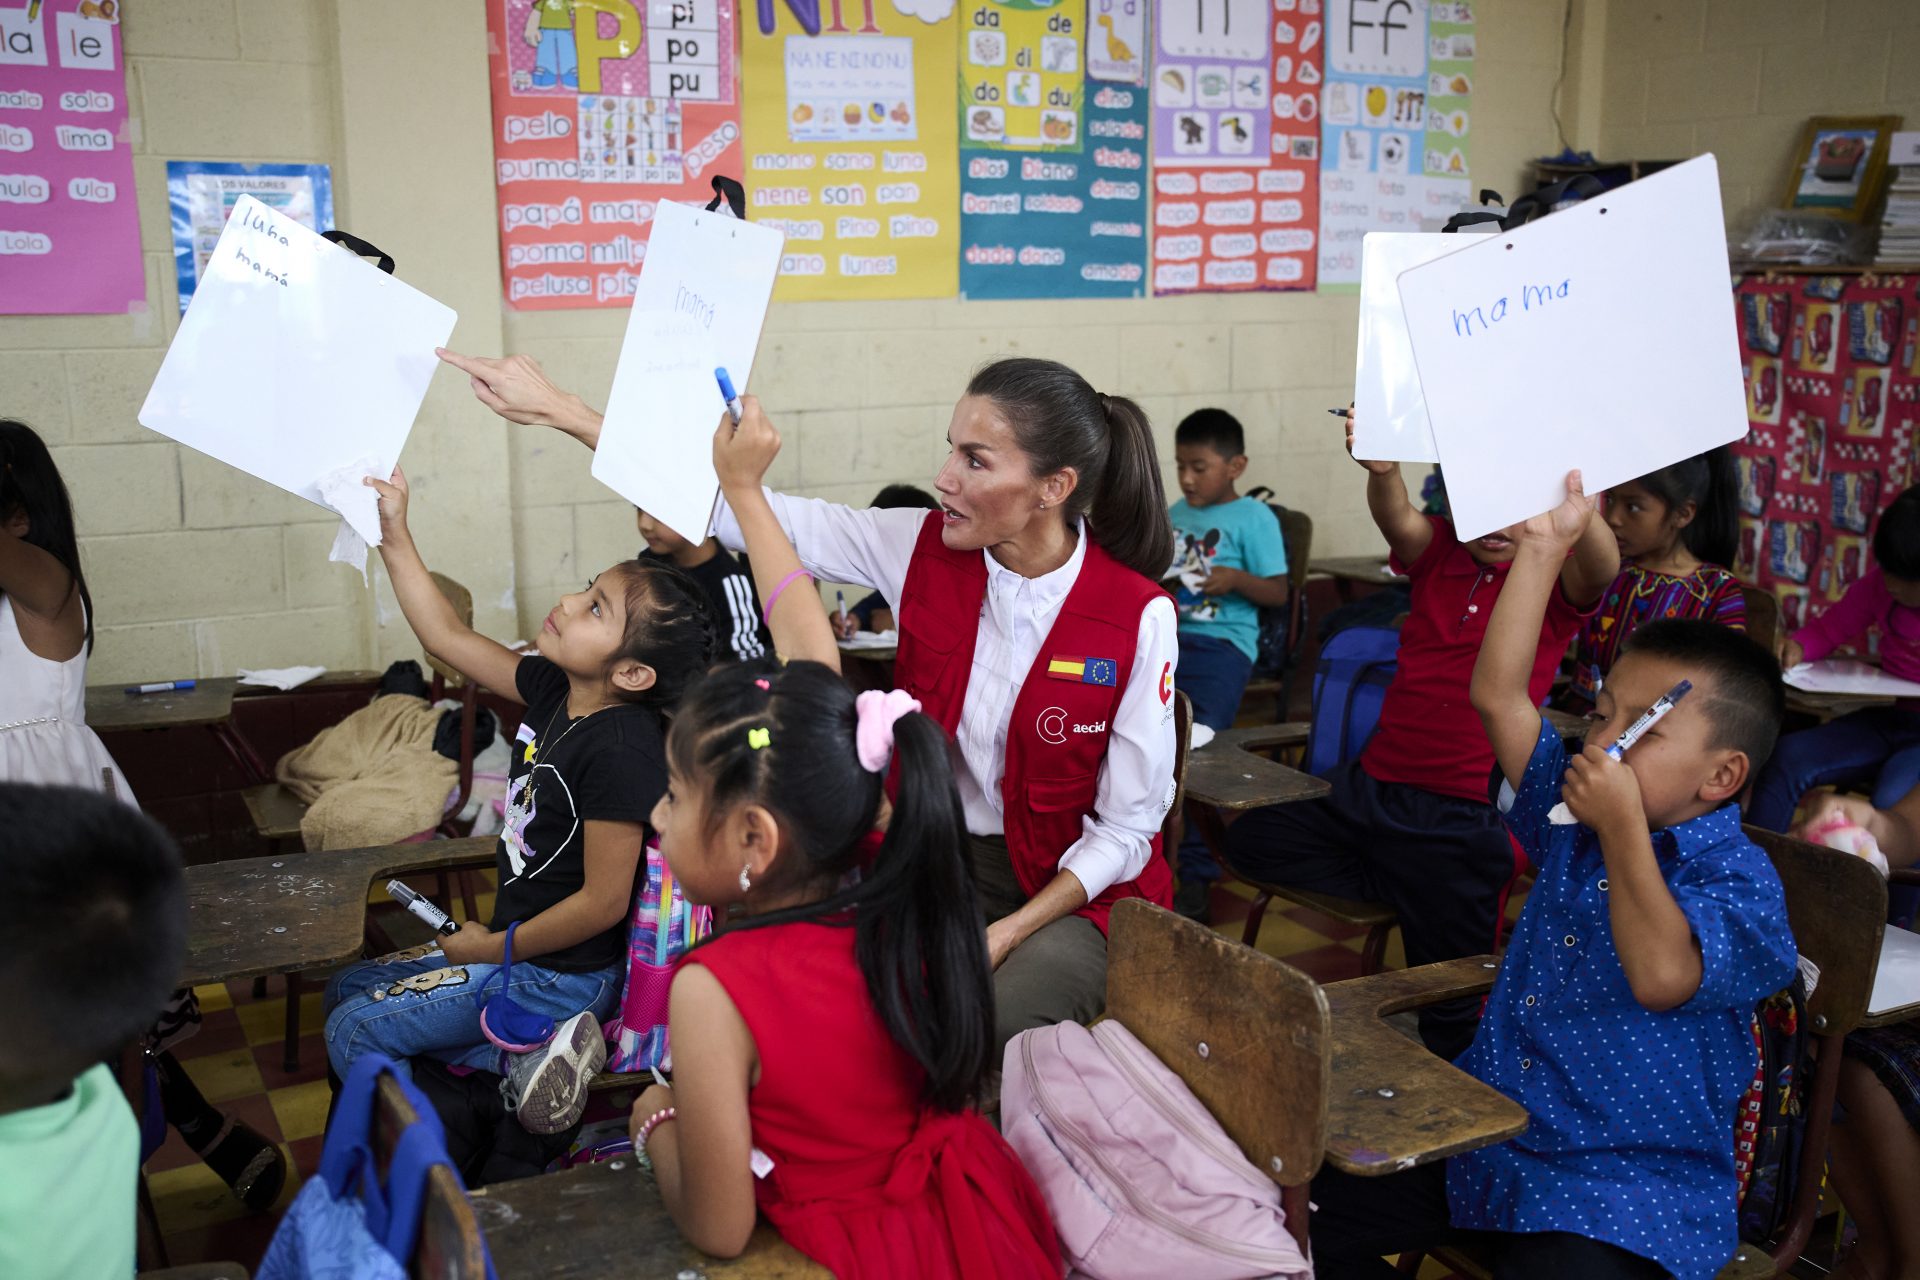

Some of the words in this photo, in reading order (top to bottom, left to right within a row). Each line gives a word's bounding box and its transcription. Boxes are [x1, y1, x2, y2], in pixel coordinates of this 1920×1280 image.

[671, 0, 695, 29] pi
[974, 8, 999, 27] da
[1047, 13, 1072, 32] de
[0, 24, 33, 54] la
[71, 28, 102, 58] le
[667, 38, 698, 62] po
[1015, 48, 1031, 67] di
[670, 73, 699, 97] pu
[974, 82, 1000, 101] do
[1047, 89, 1072, 106] du
[65, 92, 109, 108] sola
[60, 128, 108, 147] lima
[508, 113, 571, 142] pelo
[685, 122, 738, 176] peso
[755, 154, 815, 168] mono
[826, 154, 874, 169] sano
[884, 151, 925, 169] luna
[971, 160, 1007, 177] Dios
[499, 160, 579, 183] puma
[75, 181, 109, 199] ula
[755, 188, 810, 204] nene
[823, 187, 865, 205] son
[879, 185, 917, 202] pan
[966, 194, 1020, 212] Daniel
[505, 199, 581, 230] papá
[592, 202, 658, 225] map
[838, 218, 878, 237] Pino
[892, 217, 937, 238] pino
[4, 235, 44, 250] Lola
[509, 246, 586, 267] poma
[779, 255, 824, 272] ano
[844, 254, 897, 274] lunes
[513, 275, 591, 299] pelusa
[1073, 720, 1106, 734] aecid
